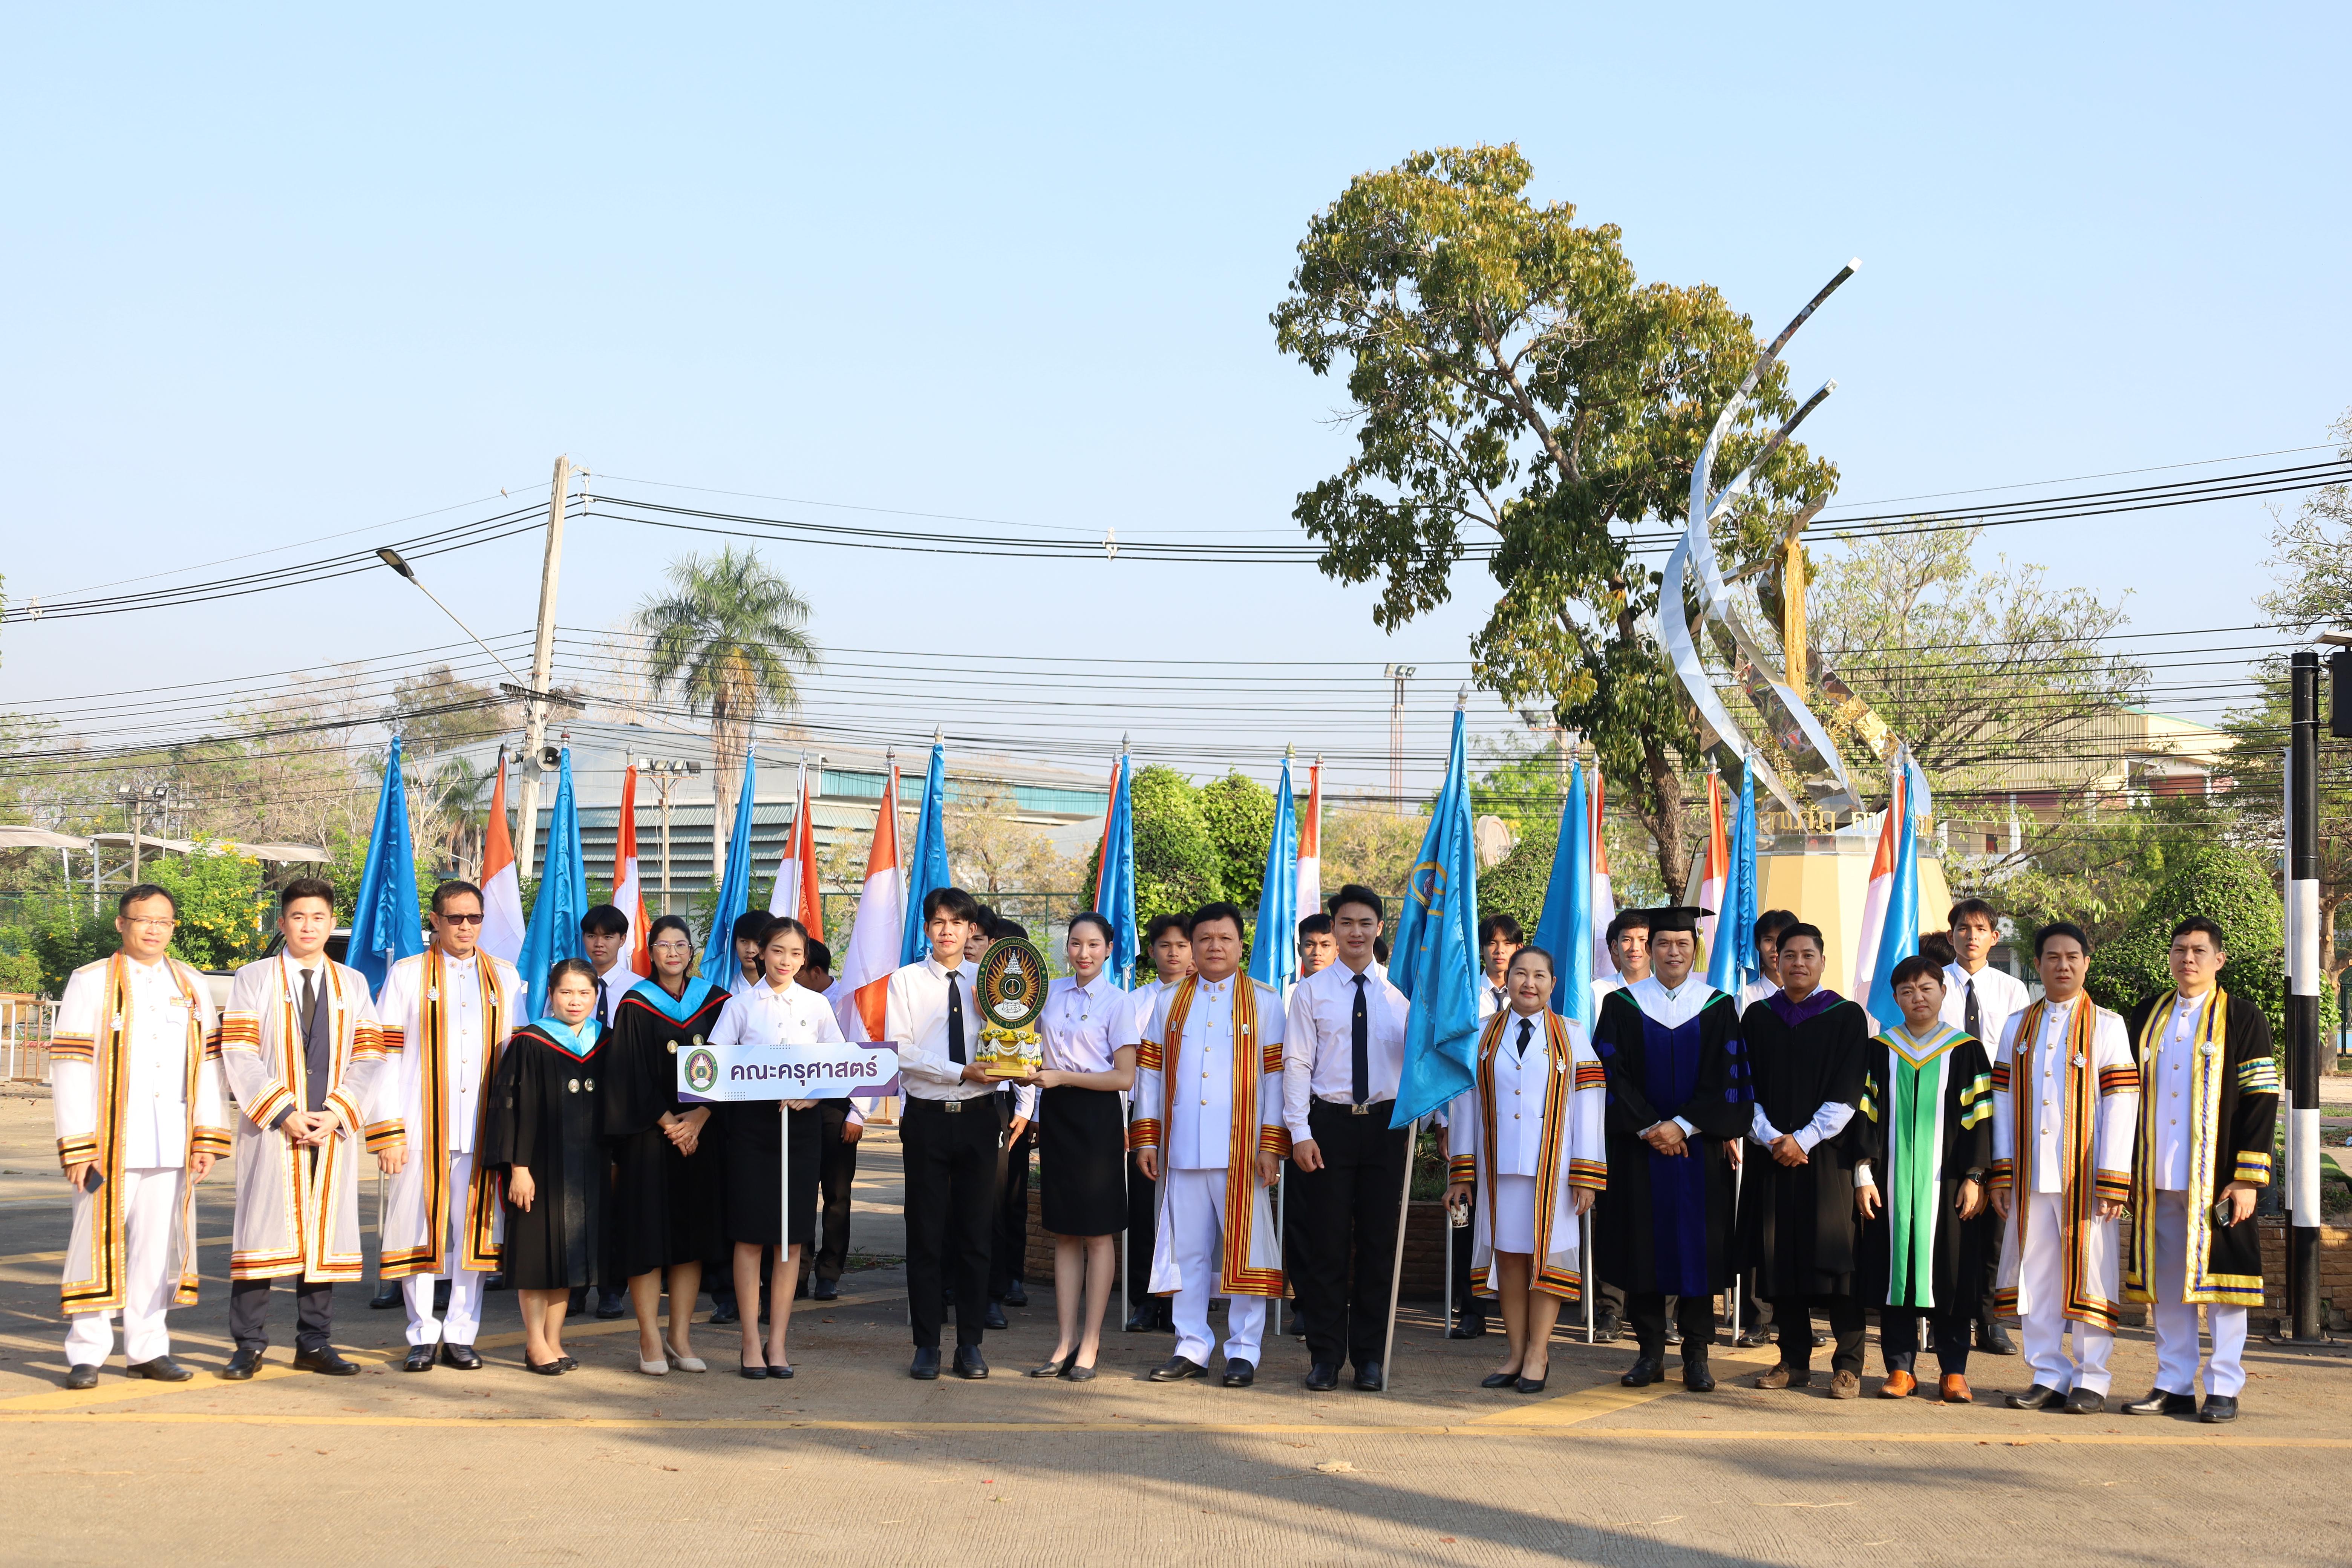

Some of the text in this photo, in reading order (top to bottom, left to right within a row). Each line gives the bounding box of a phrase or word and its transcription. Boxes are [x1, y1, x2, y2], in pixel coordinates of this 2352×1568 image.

[979, 975, 1047, 1027] KAMPHAENG PHET RAJABHAT UNIVERSITY
[731, 1055, 877, 1086] คณะครุศาสตร์
